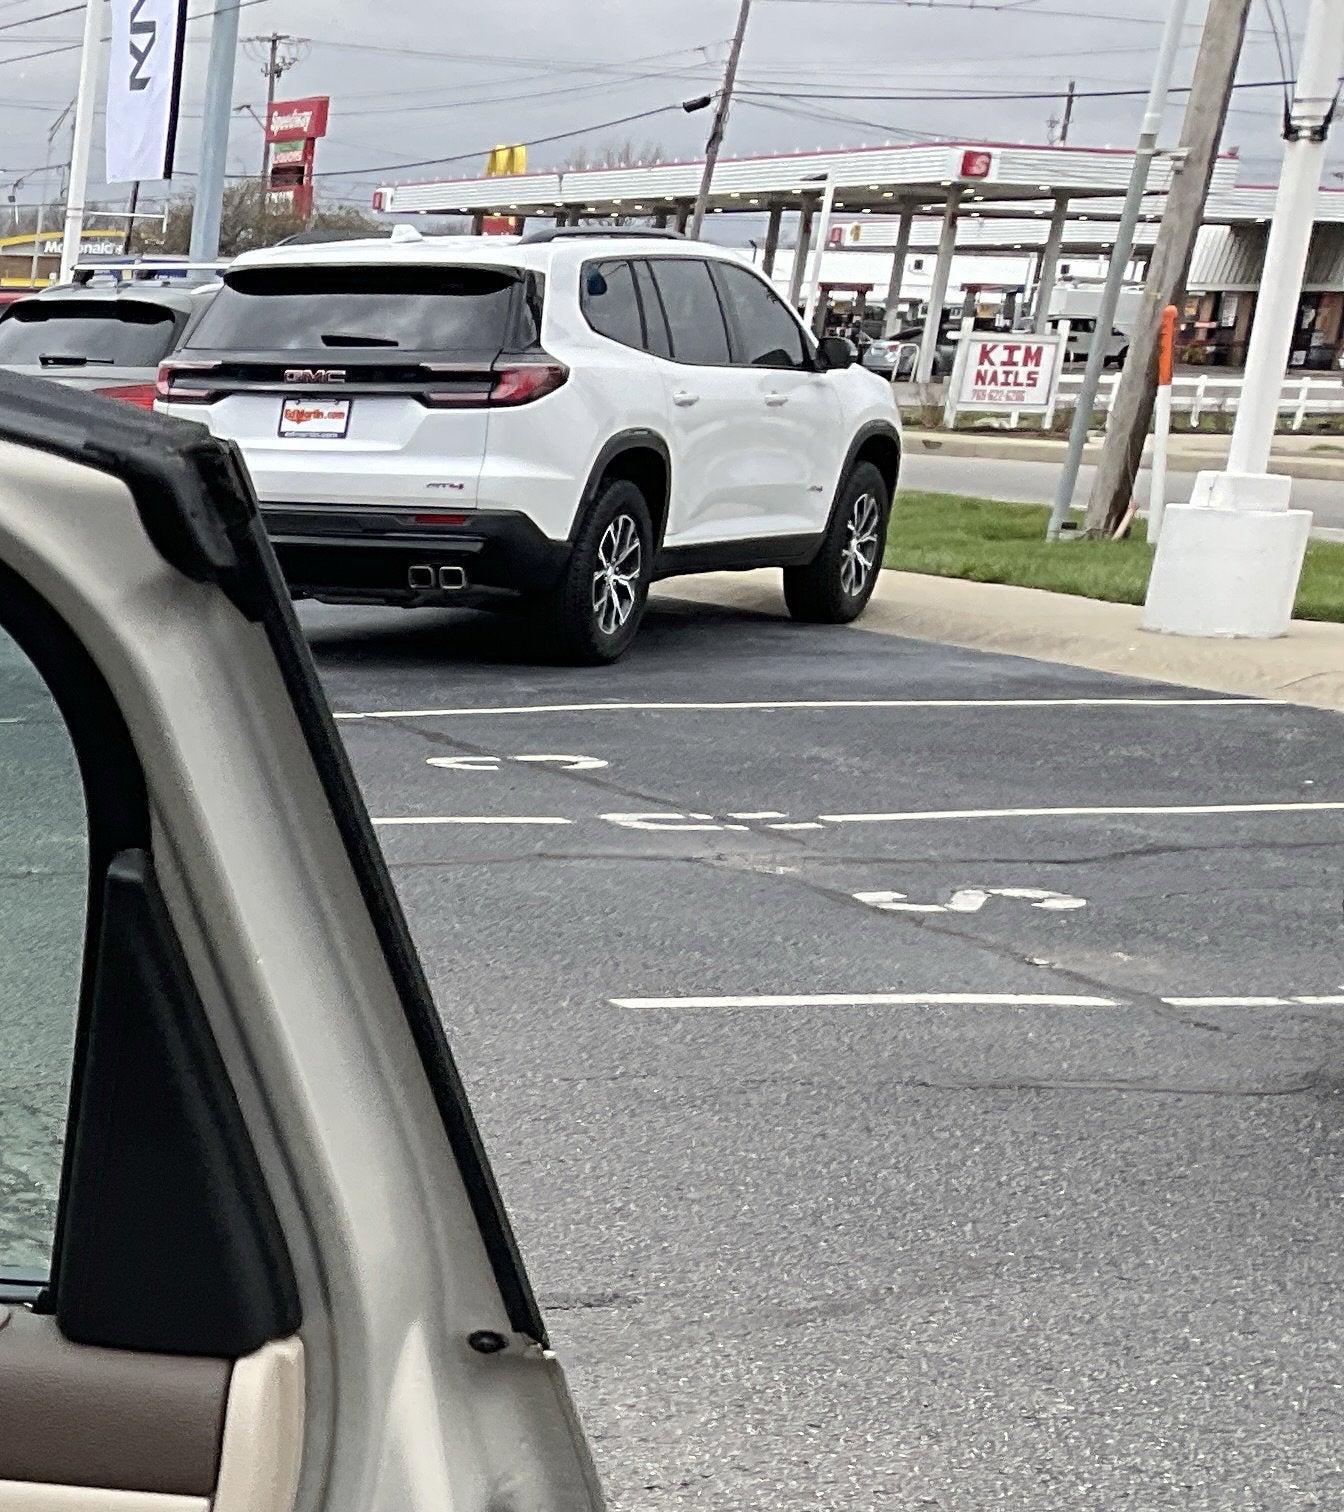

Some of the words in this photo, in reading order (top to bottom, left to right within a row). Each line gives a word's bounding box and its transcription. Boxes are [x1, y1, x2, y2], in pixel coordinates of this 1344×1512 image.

[978, 343, 1043, 367] KIM
[284, 369, 346, 383] GMC
[974, 370, 1039, 387] NAILS
